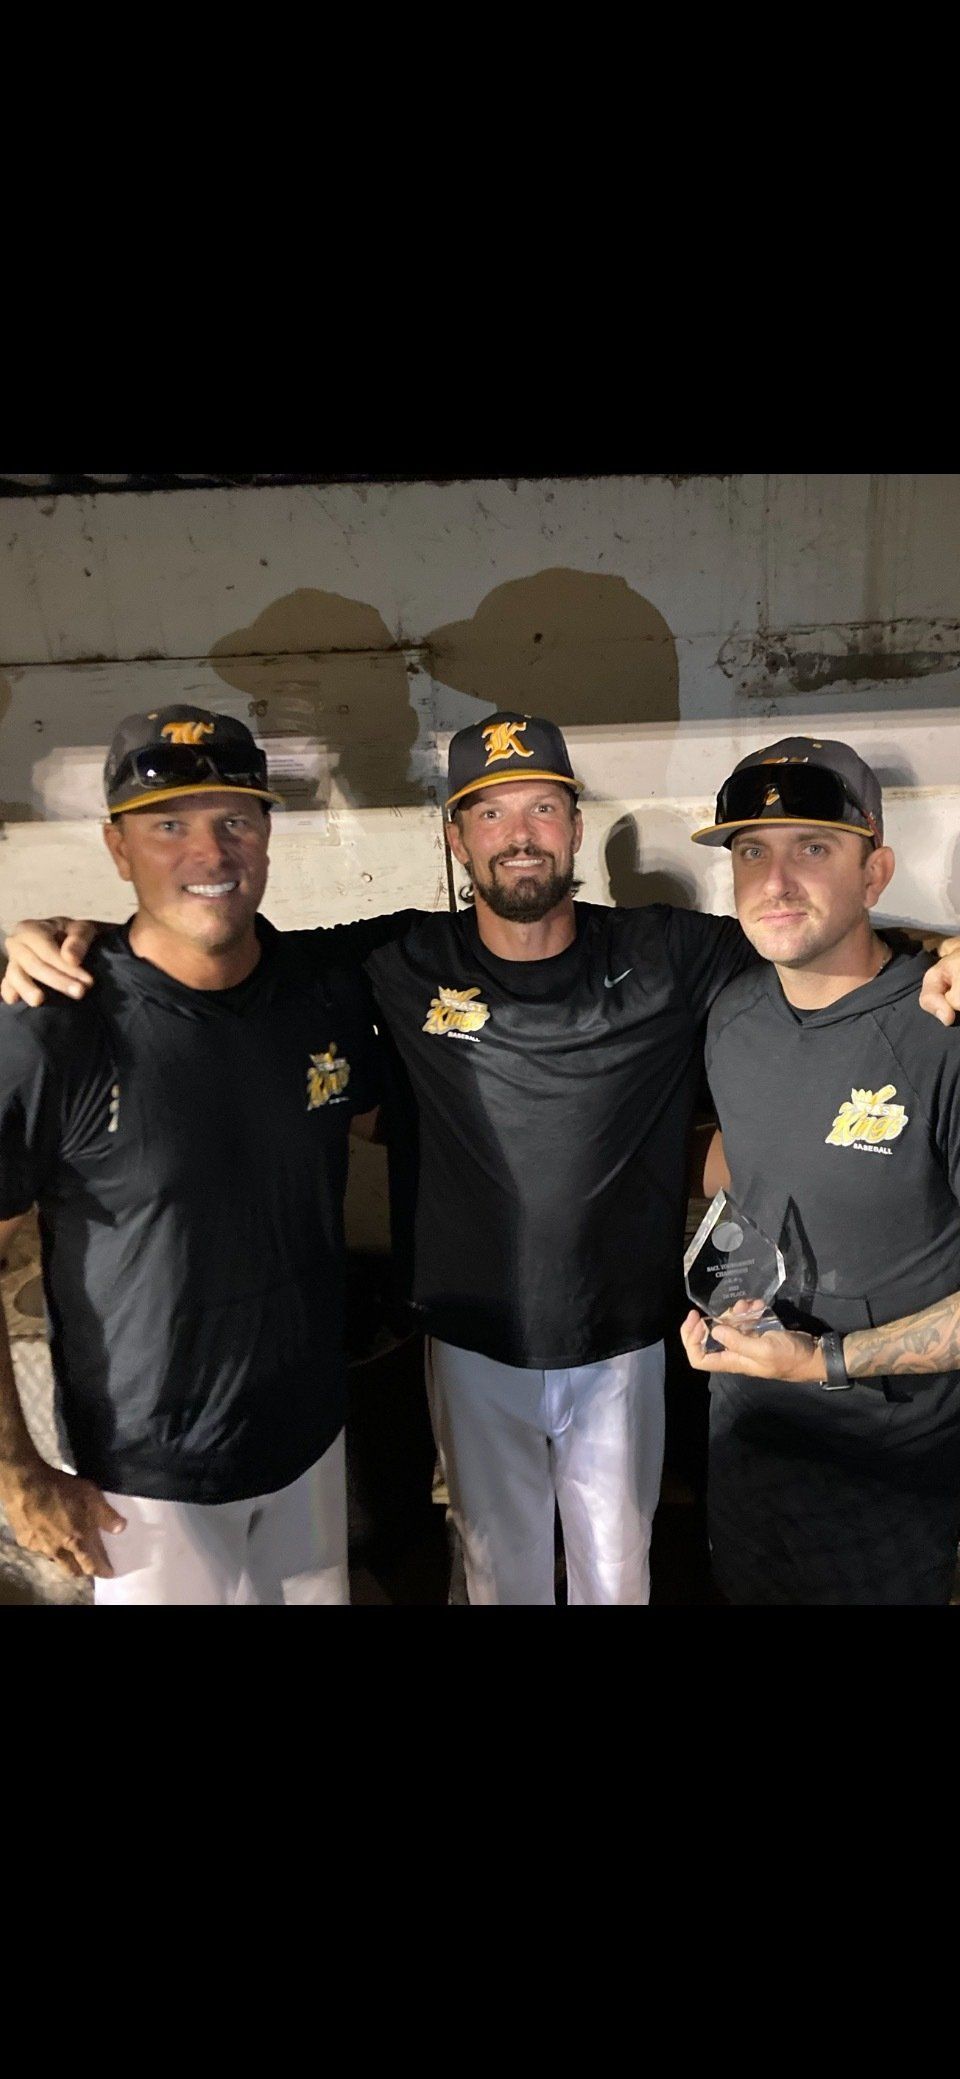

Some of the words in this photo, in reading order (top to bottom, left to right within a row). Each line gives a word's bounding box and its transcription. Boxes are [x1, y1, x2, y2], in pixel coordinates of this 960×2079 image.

[482, 721, 535, 768] K
[825, 1102, 908, 1146] Kings
[853, 1143, 893, 1155] BASEBALL
